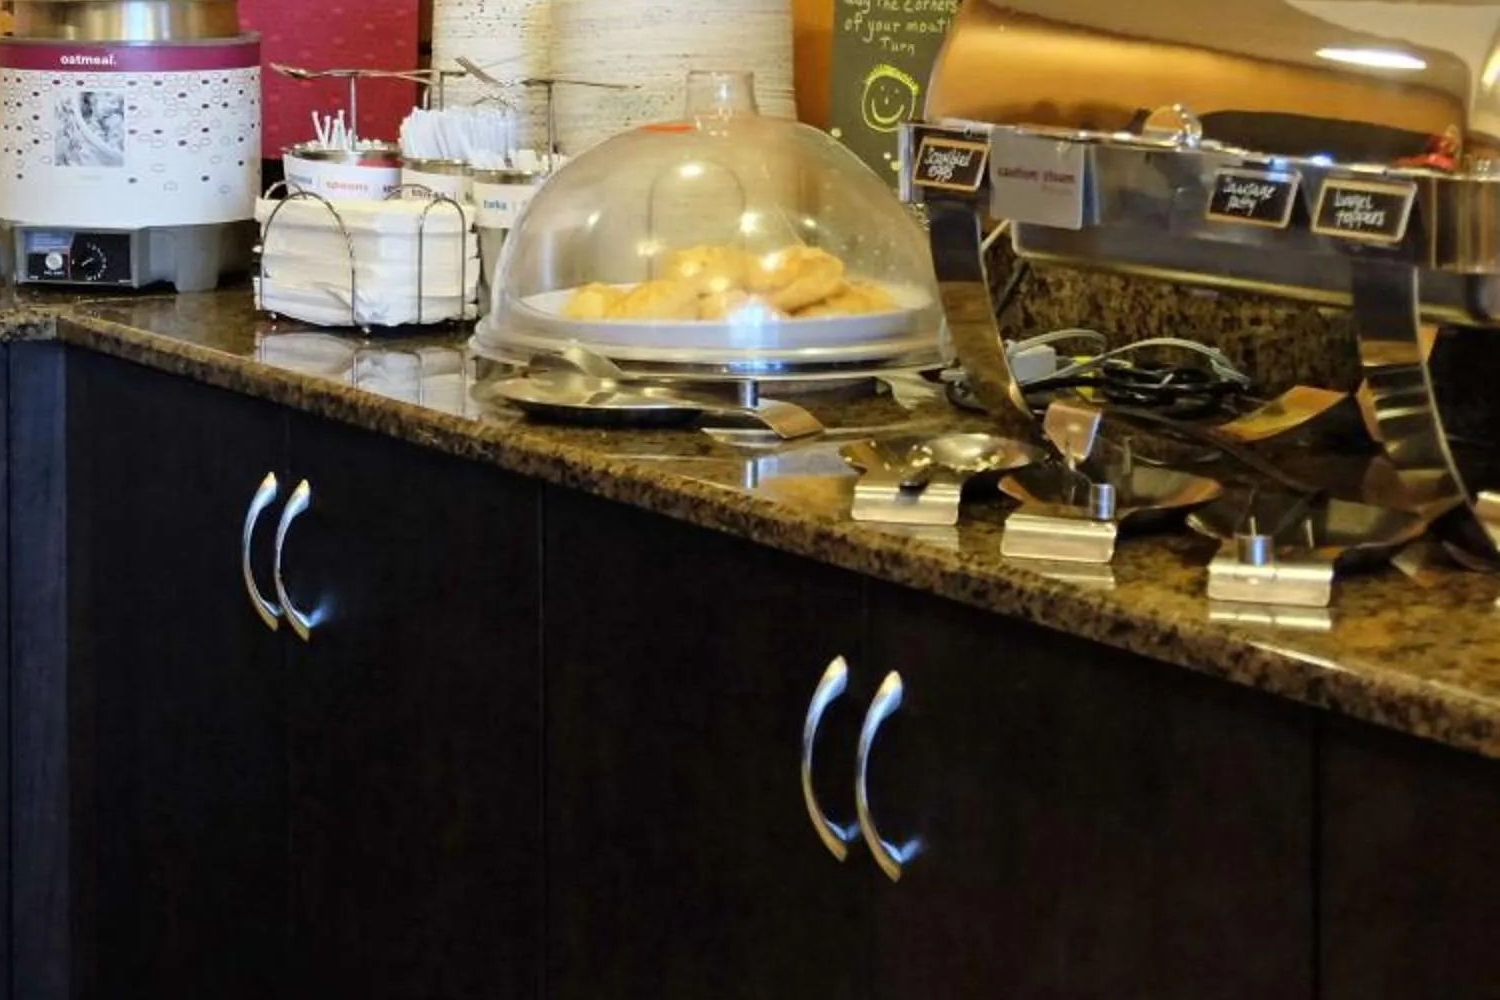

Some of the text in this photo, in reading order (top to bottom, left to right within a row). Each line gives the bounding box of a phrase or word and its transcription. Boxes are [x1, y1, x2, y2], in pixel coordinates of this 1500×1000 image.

[903, 0, 958, 13] corners
[844, 12, 864, 32] of
[861, 19, 901, 43] your
[879, 35, 915, 58] Turn
